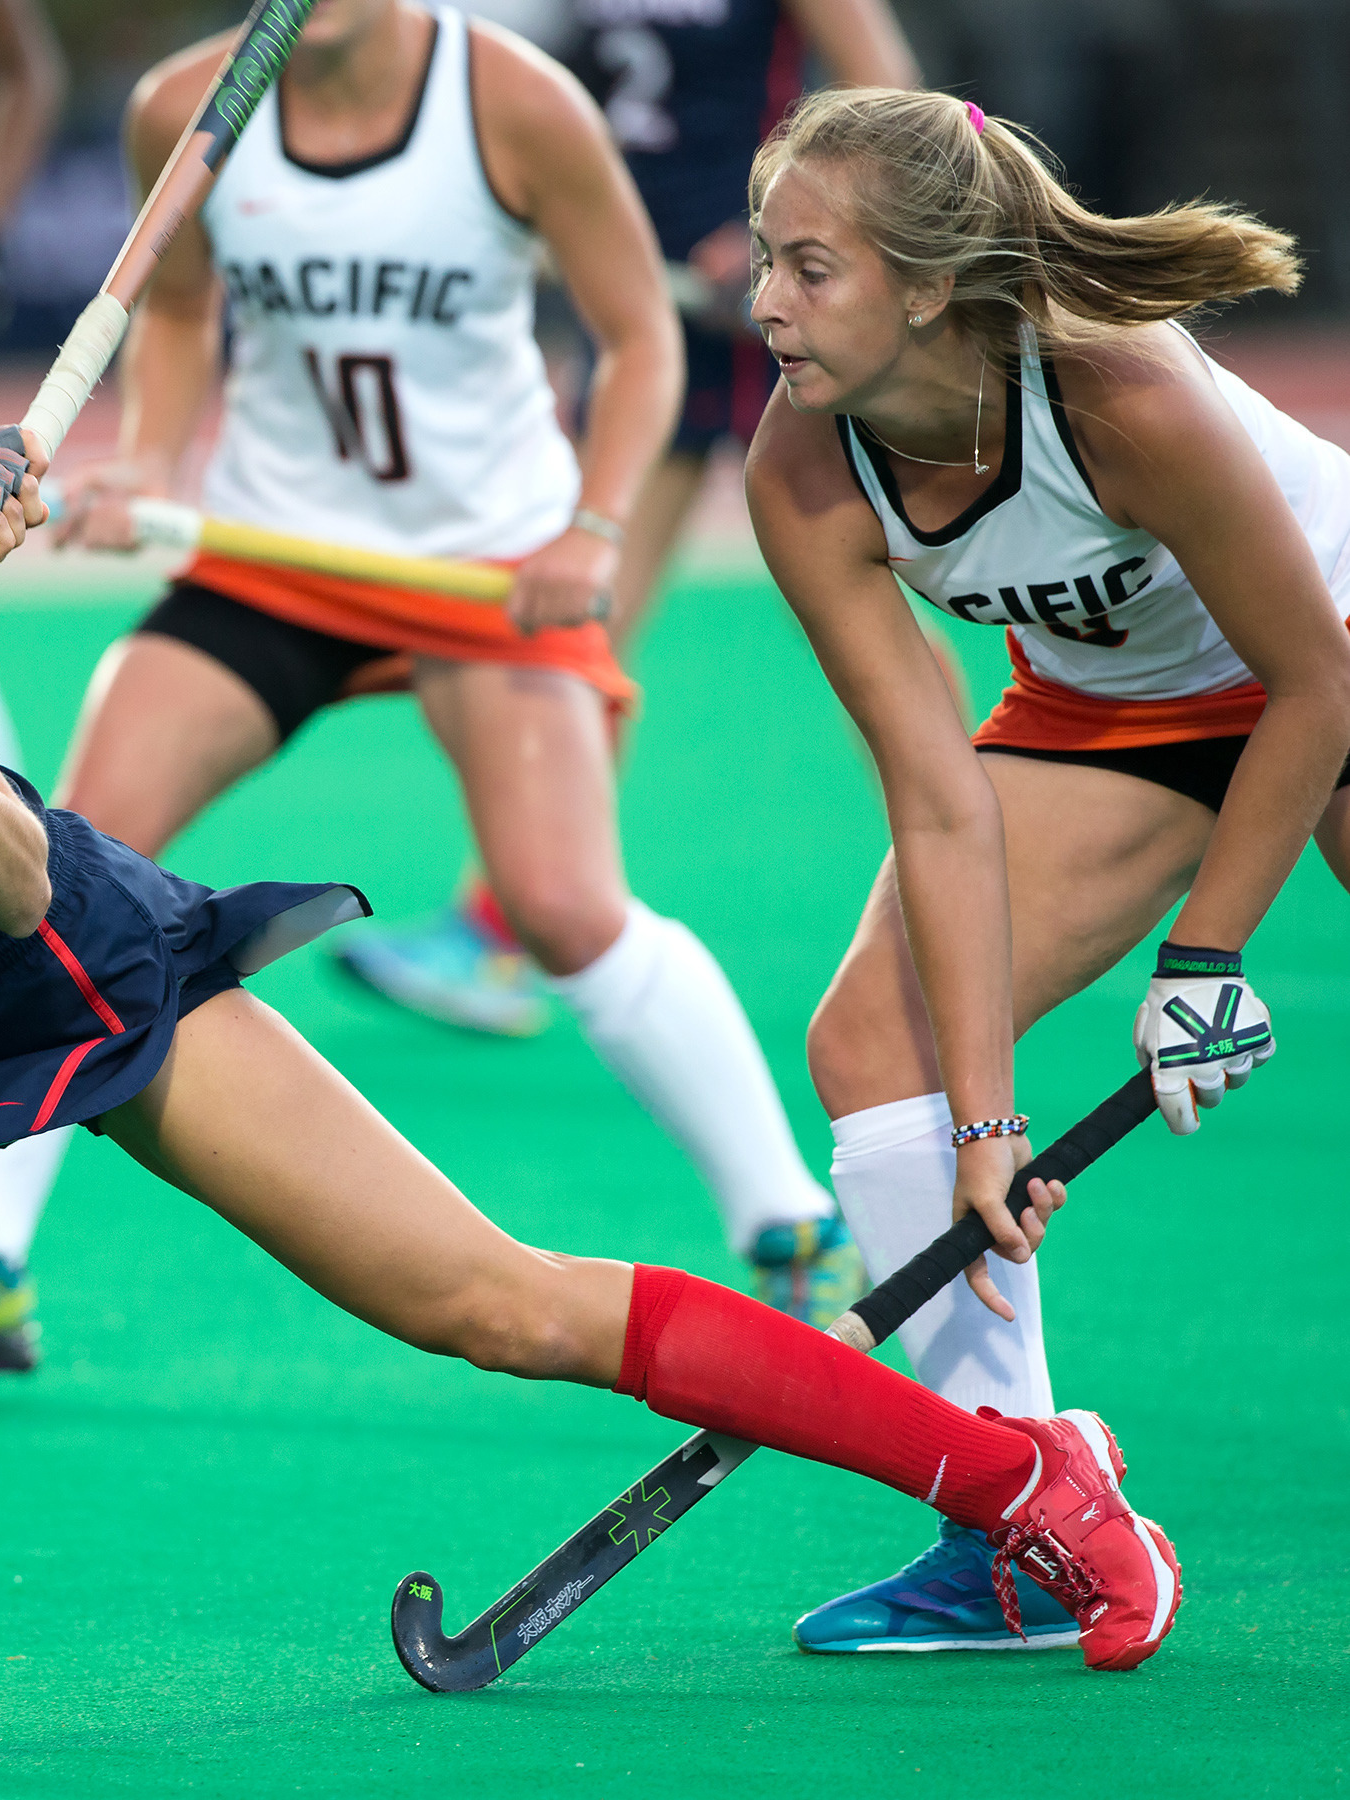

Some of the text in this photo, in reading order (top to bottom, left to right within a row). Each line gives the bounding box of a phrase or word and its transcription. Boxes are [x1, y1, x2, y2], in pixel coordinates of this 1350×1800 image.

[1204, 1037, 1236, 1058] 大阪
[408, 1581, 434, 1602] 大阪
[1088, 1601, 1109, 1625] JDH
